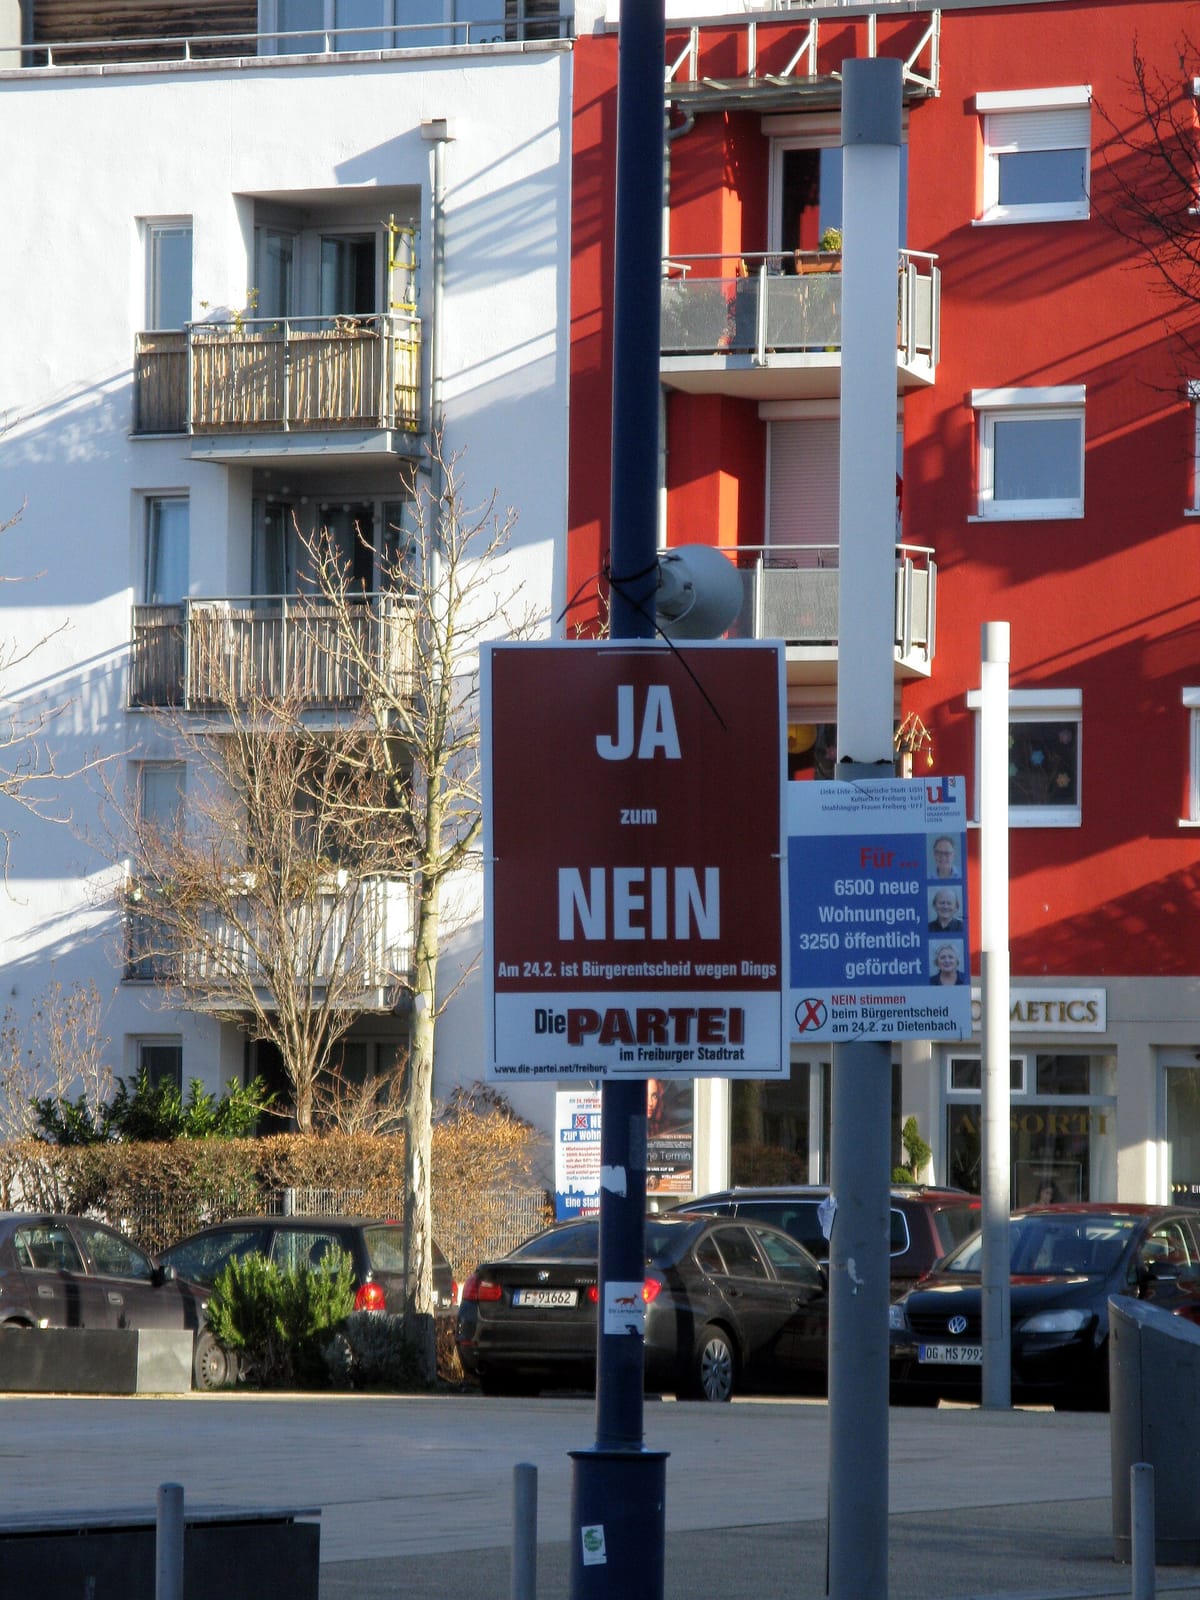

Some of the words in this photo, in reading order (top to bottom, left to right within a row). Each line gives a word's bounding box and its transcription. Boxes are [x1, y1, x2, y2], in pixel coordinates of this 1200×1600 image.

[595, 685, 681, 761] JA
[620, 808, 657, 825] zum
[860, 848, 895, 869] Für
[834, 879, 875, 896] 6500
[879, 881, 919, 894] neue
[558, 867, 720, 941] NEIN
[818, 905, 921, 924] Wohnungen,
[800, 934, 840, 950] 3250
[844, 933, 920, 949] öffentlich
[498, 962, 519, 977] Am
[523, 962, 556, 977] 24.2.
[560, 961, 579, 977] ist
[582, 961, 691, 980] Bürgerentscheid
[694, 964, 737, 979] wegen
[741, 960, 777, 979] Dings
[845, 958, 922, 979] gefördert
[831, 995, 857, 1006] NEIN
[859, 994, 906, 1005] stimmen
[831, 1008, 858, 1019] beim
[861, 1006, 949, 1020] Bürgerentscheid
[534, 1008, 567, 1034] Die
[567, 1008, 745, 1047] PARTEI
[832, 1023, 849, 1033] am
[851, 1021, 879, 1033] 24.2.
[881, 1022, 894, 1032] zu
[896, 1020, 958, 1032] Dietenbach
[619, 1048, 634, 1062] im
[637, 1047, 695, 1063] Freiburger
[697, 1047, 745, 1061] Stadtrat
[494, 1063, 608, 1075] www.die-partei.net/freiburg
[926, 1348, 938, 1359] OG
